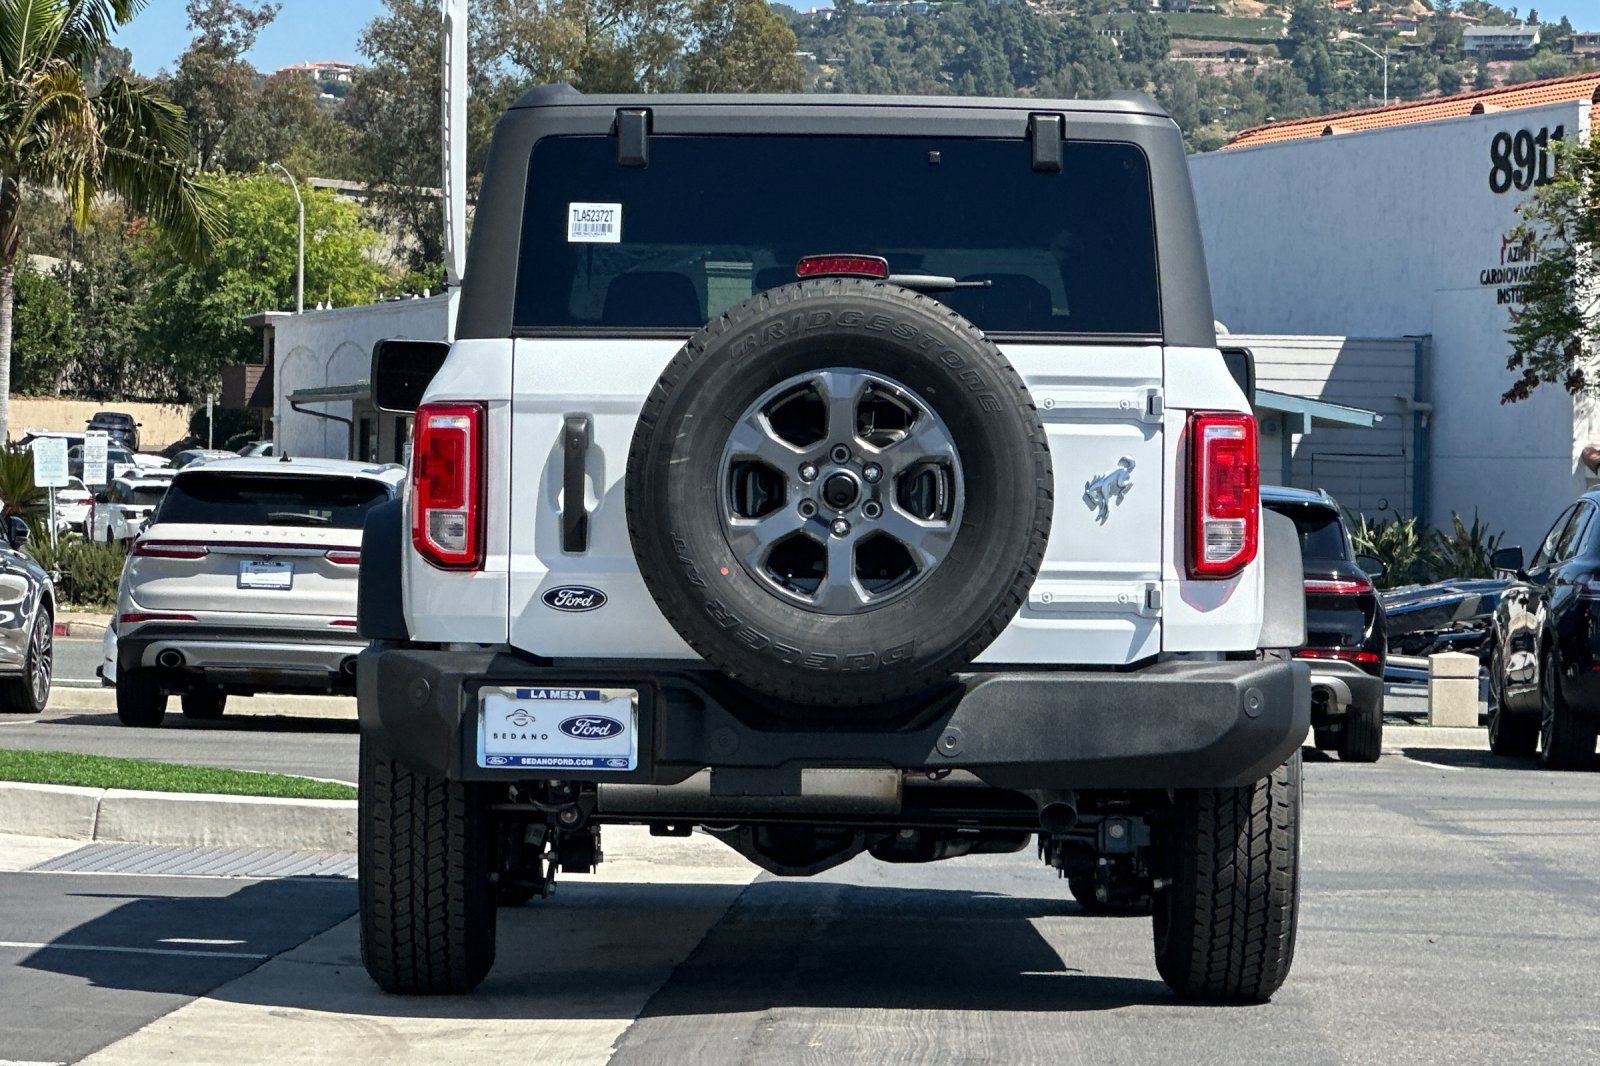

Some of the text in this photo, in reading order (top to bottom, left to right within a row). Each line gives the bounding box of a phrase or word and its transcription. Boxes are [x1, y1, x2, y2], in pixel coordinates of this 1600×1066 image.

[573, 209, 614, 223] TLA52372T
[729, 310, 1003, 414] BRIDGESTONE
[554, 590, 594, 607] Ford
[705, 598, 917, 672] DUELER
[530, 690, 586, 700] LA MESA
[571, 717, 611, 736] Ford
[493, 732, 548, 740] SEDANO
[521, 757, 594, 766] SEDANOFORD.COM
